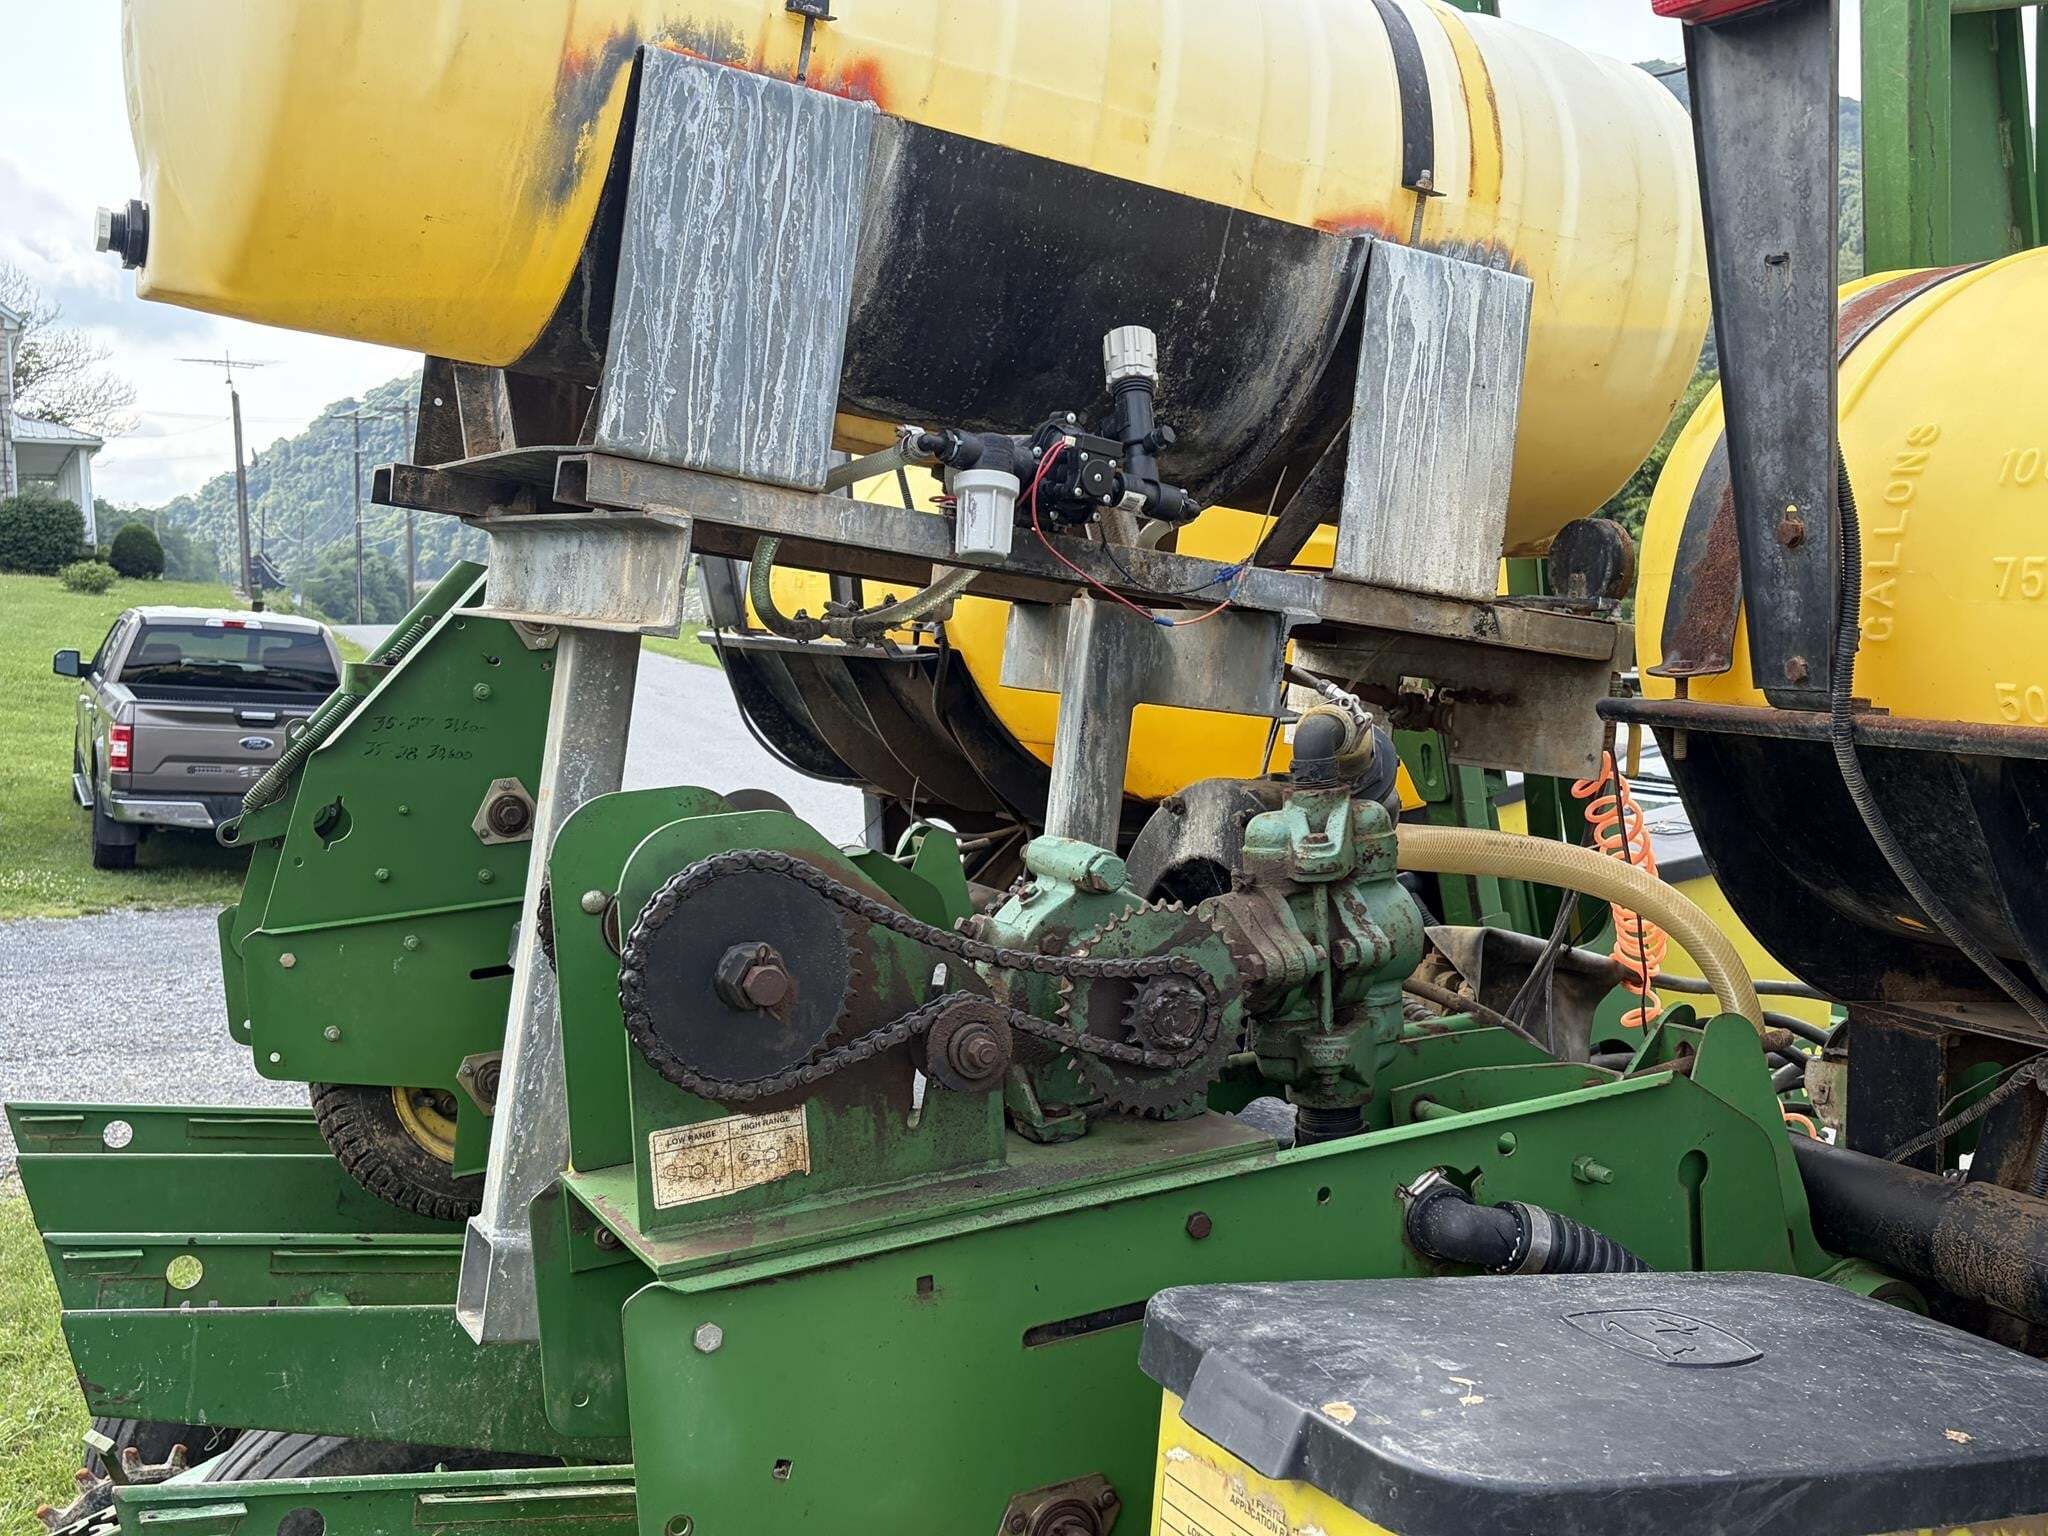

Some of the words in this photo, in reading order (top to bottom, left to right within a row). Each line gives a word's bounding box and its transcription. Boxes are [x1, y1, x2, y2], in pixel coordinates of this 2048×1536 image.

[1999, 447, 2048, 485] 10
[1864, 422, 1941, 642] GALLONS
[1992, 556, 2048, 599] 75
[1994, 682, 2048, 724] 50
[667, 1135, 687, 1148] LOW
[687, 1130, 717, 1144] RANGE
[740, 1120, 761, 1132] HIGH
[762, 1115, 790, 1127] RANGE
